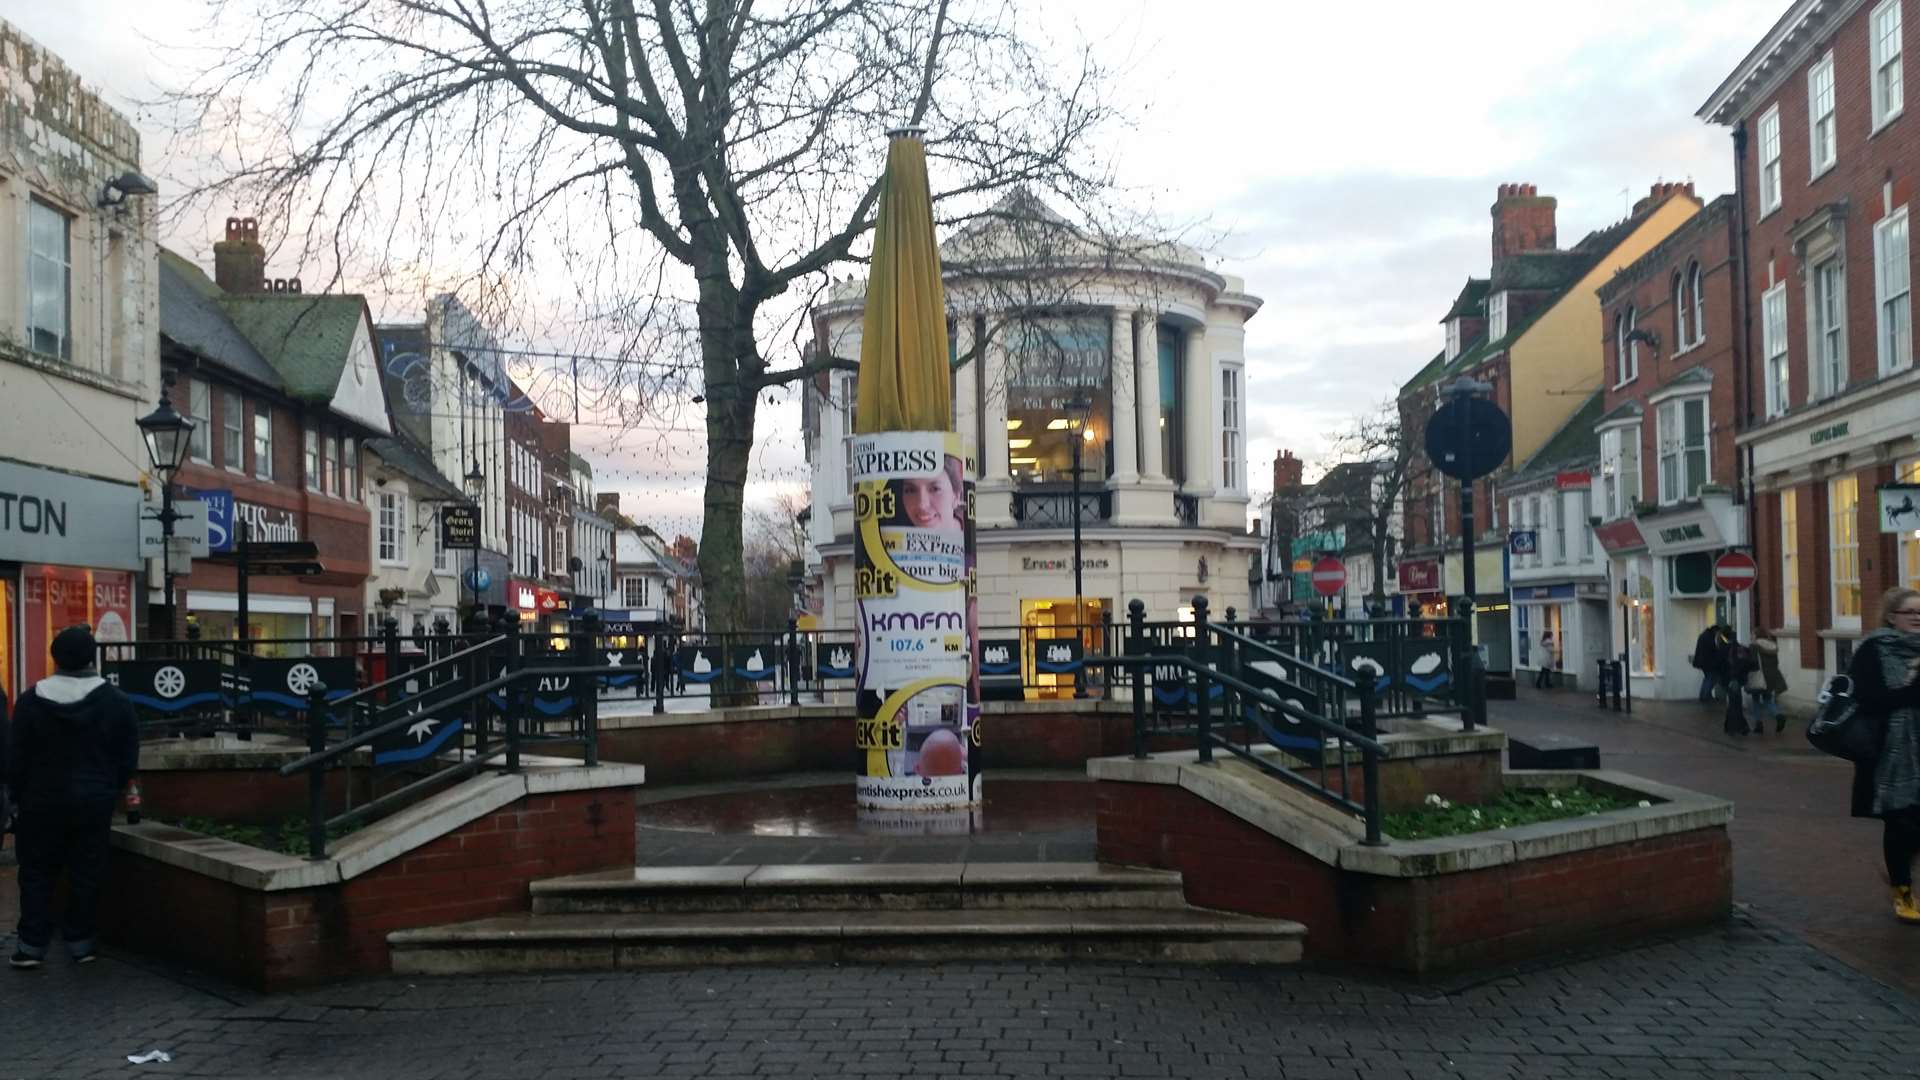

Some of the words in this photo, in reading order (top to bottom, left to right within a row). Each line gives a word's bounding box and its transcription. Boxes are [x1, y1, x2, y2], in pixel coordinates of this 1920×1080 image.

[875, 489, 893, 515] it
[95, 583, 127, 608] SALE
[890, 639, 924, 652] 107.6
[944, 643, 959, 652] KM
[882, 721, 900, 746] it
